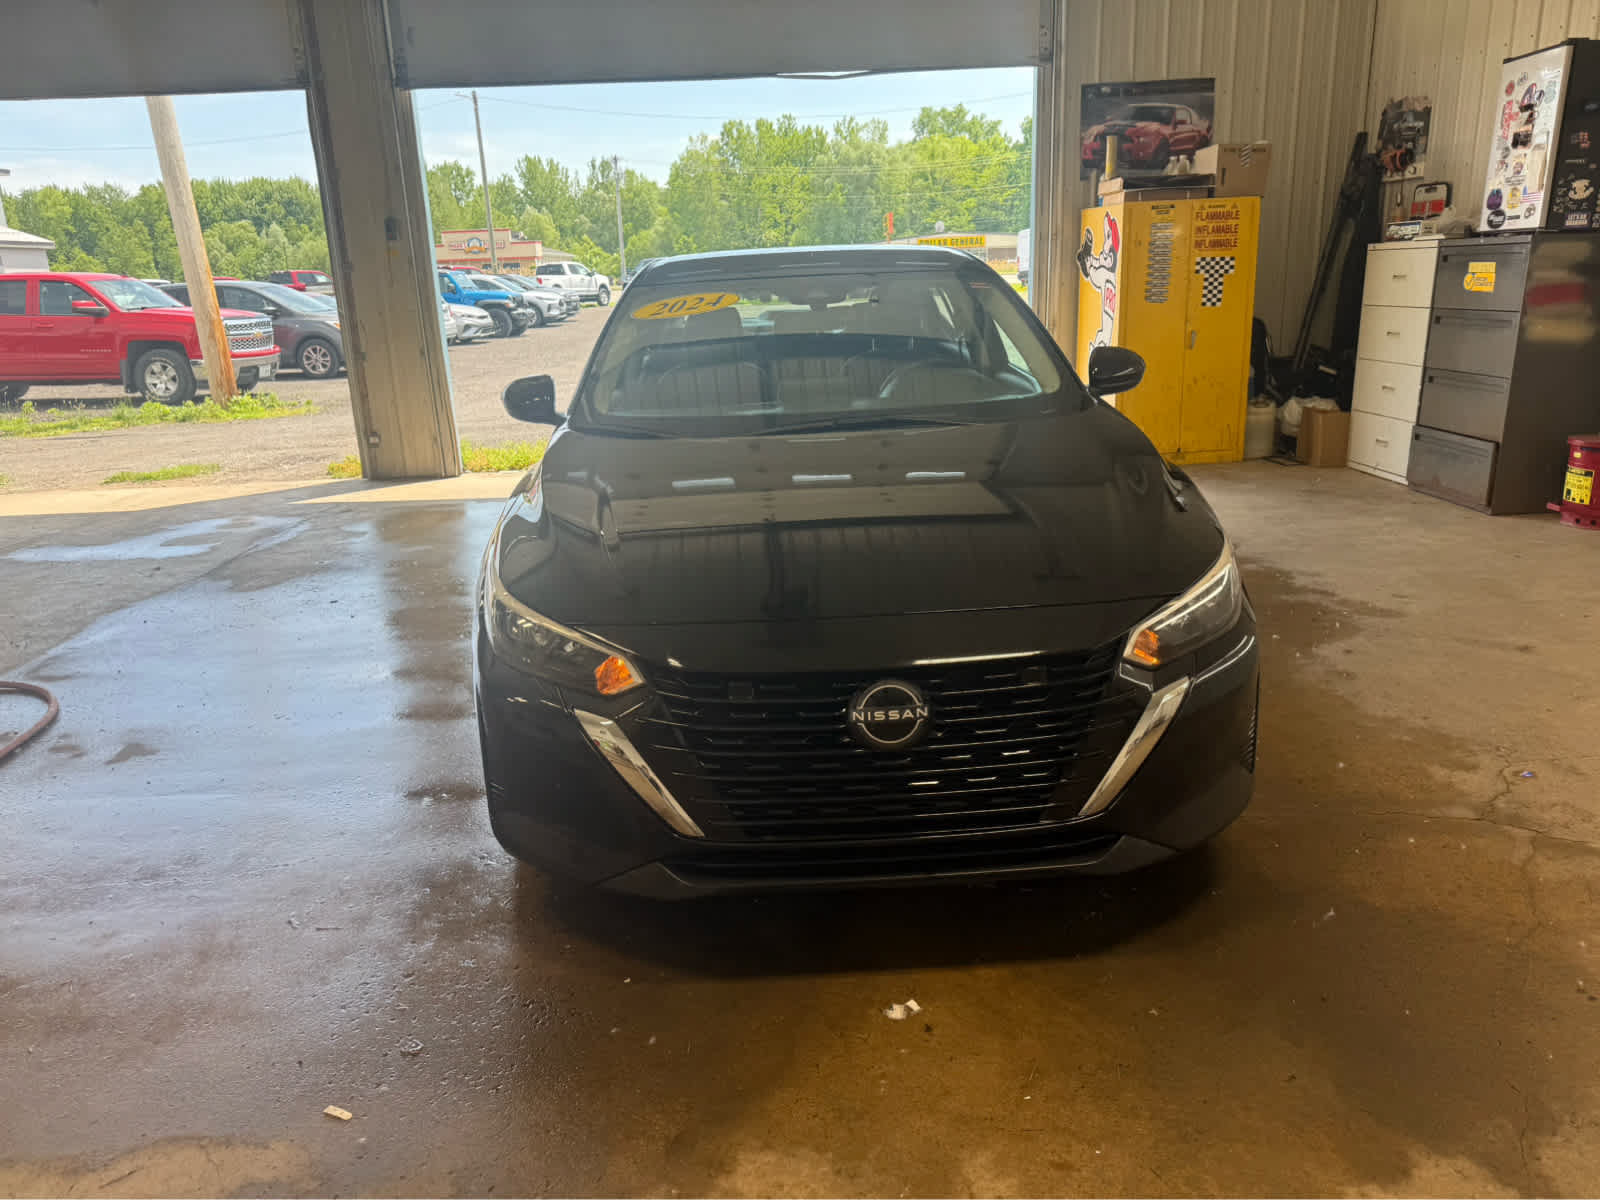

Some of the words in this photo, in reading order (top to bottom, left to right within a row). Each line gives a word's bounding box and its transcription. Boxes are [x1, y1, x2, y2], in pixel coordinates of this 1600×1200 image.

[1195, 210, 1240, 221] FLAMMABLE
[648, 293, 726, 316] 2024
[852, 706, 929, 721] NISSAN
